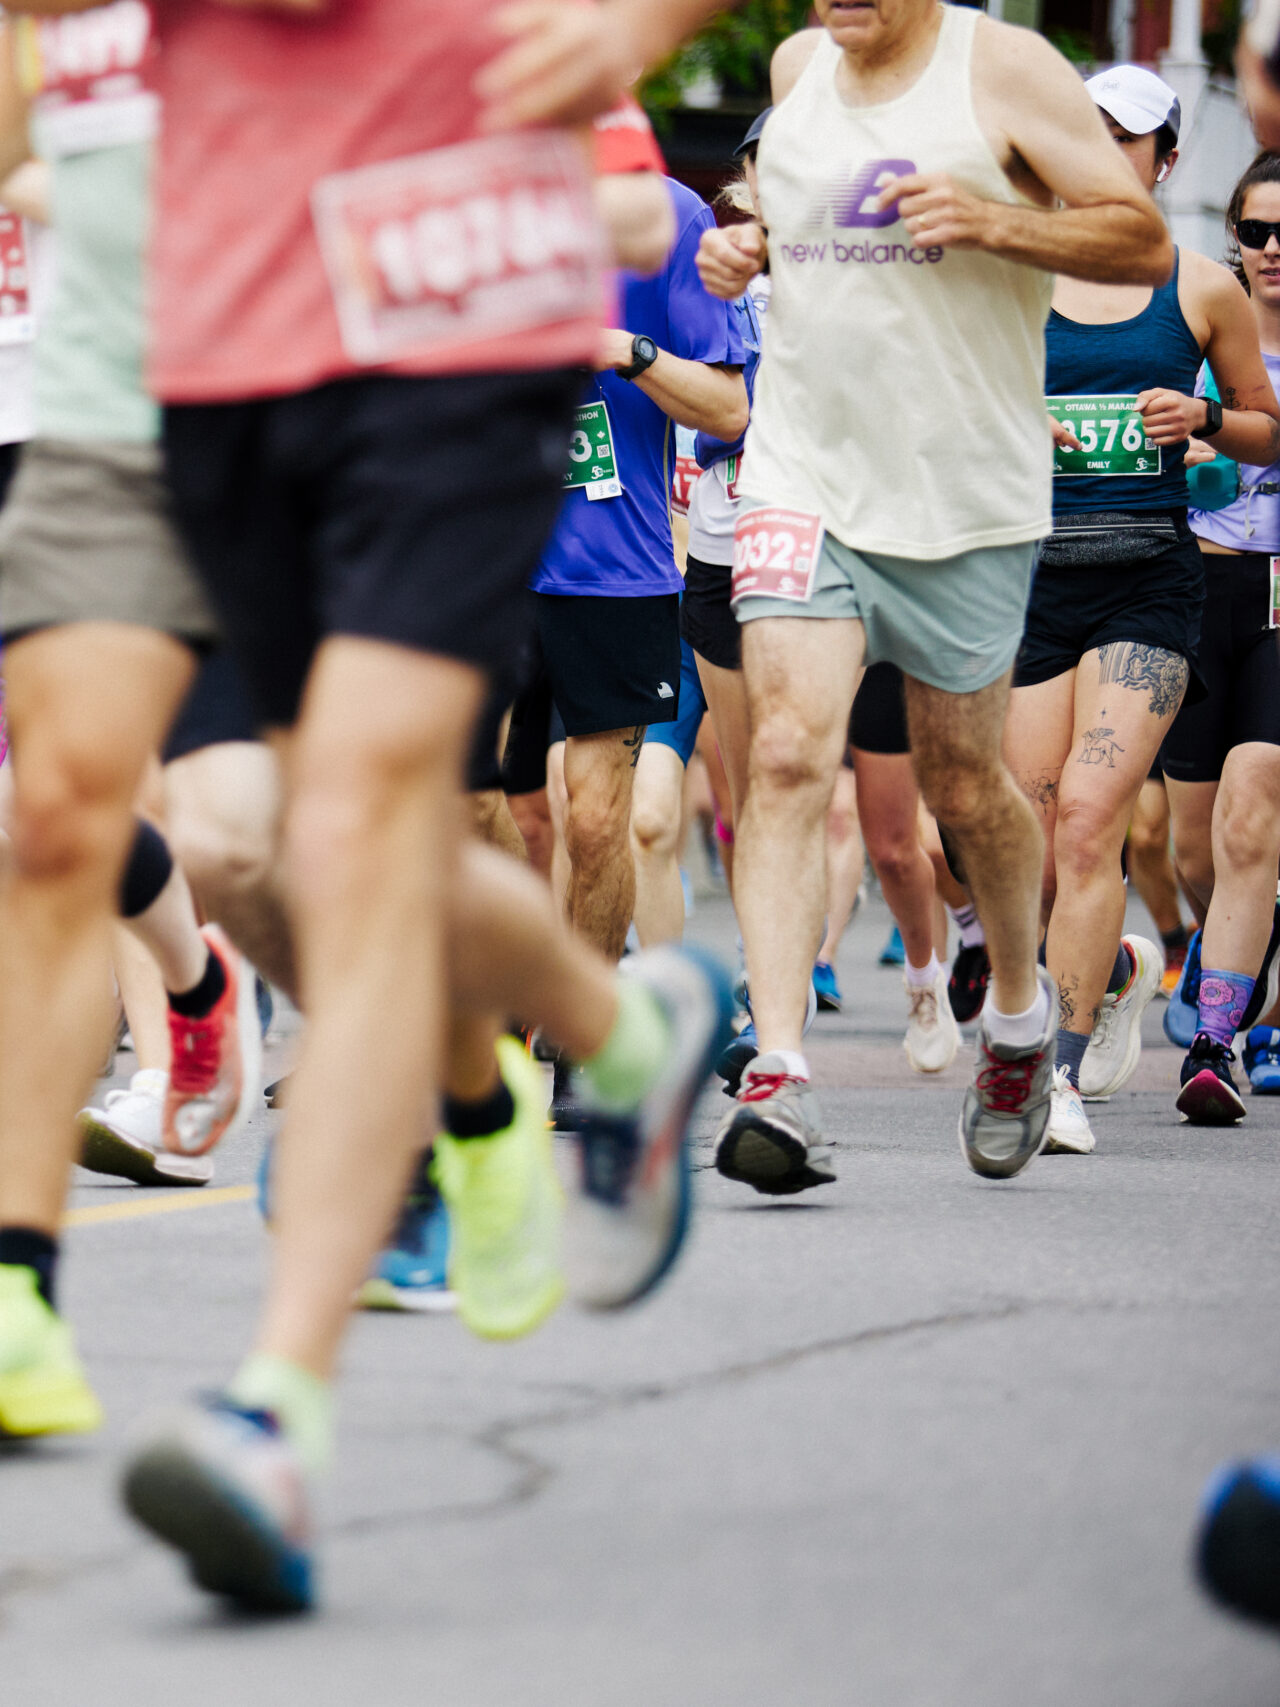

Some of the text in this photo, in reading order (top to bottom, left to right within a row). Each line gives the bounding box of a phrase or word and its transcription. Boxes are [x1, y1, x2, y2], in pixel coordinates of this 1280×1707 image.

[781, 239, 944, 265] new balance
[1065, 403, 1097, 411] OTTAWA
[1108, 402, 1137, 410] MARAT
[1087, 461, 1111, 469] EMILY
